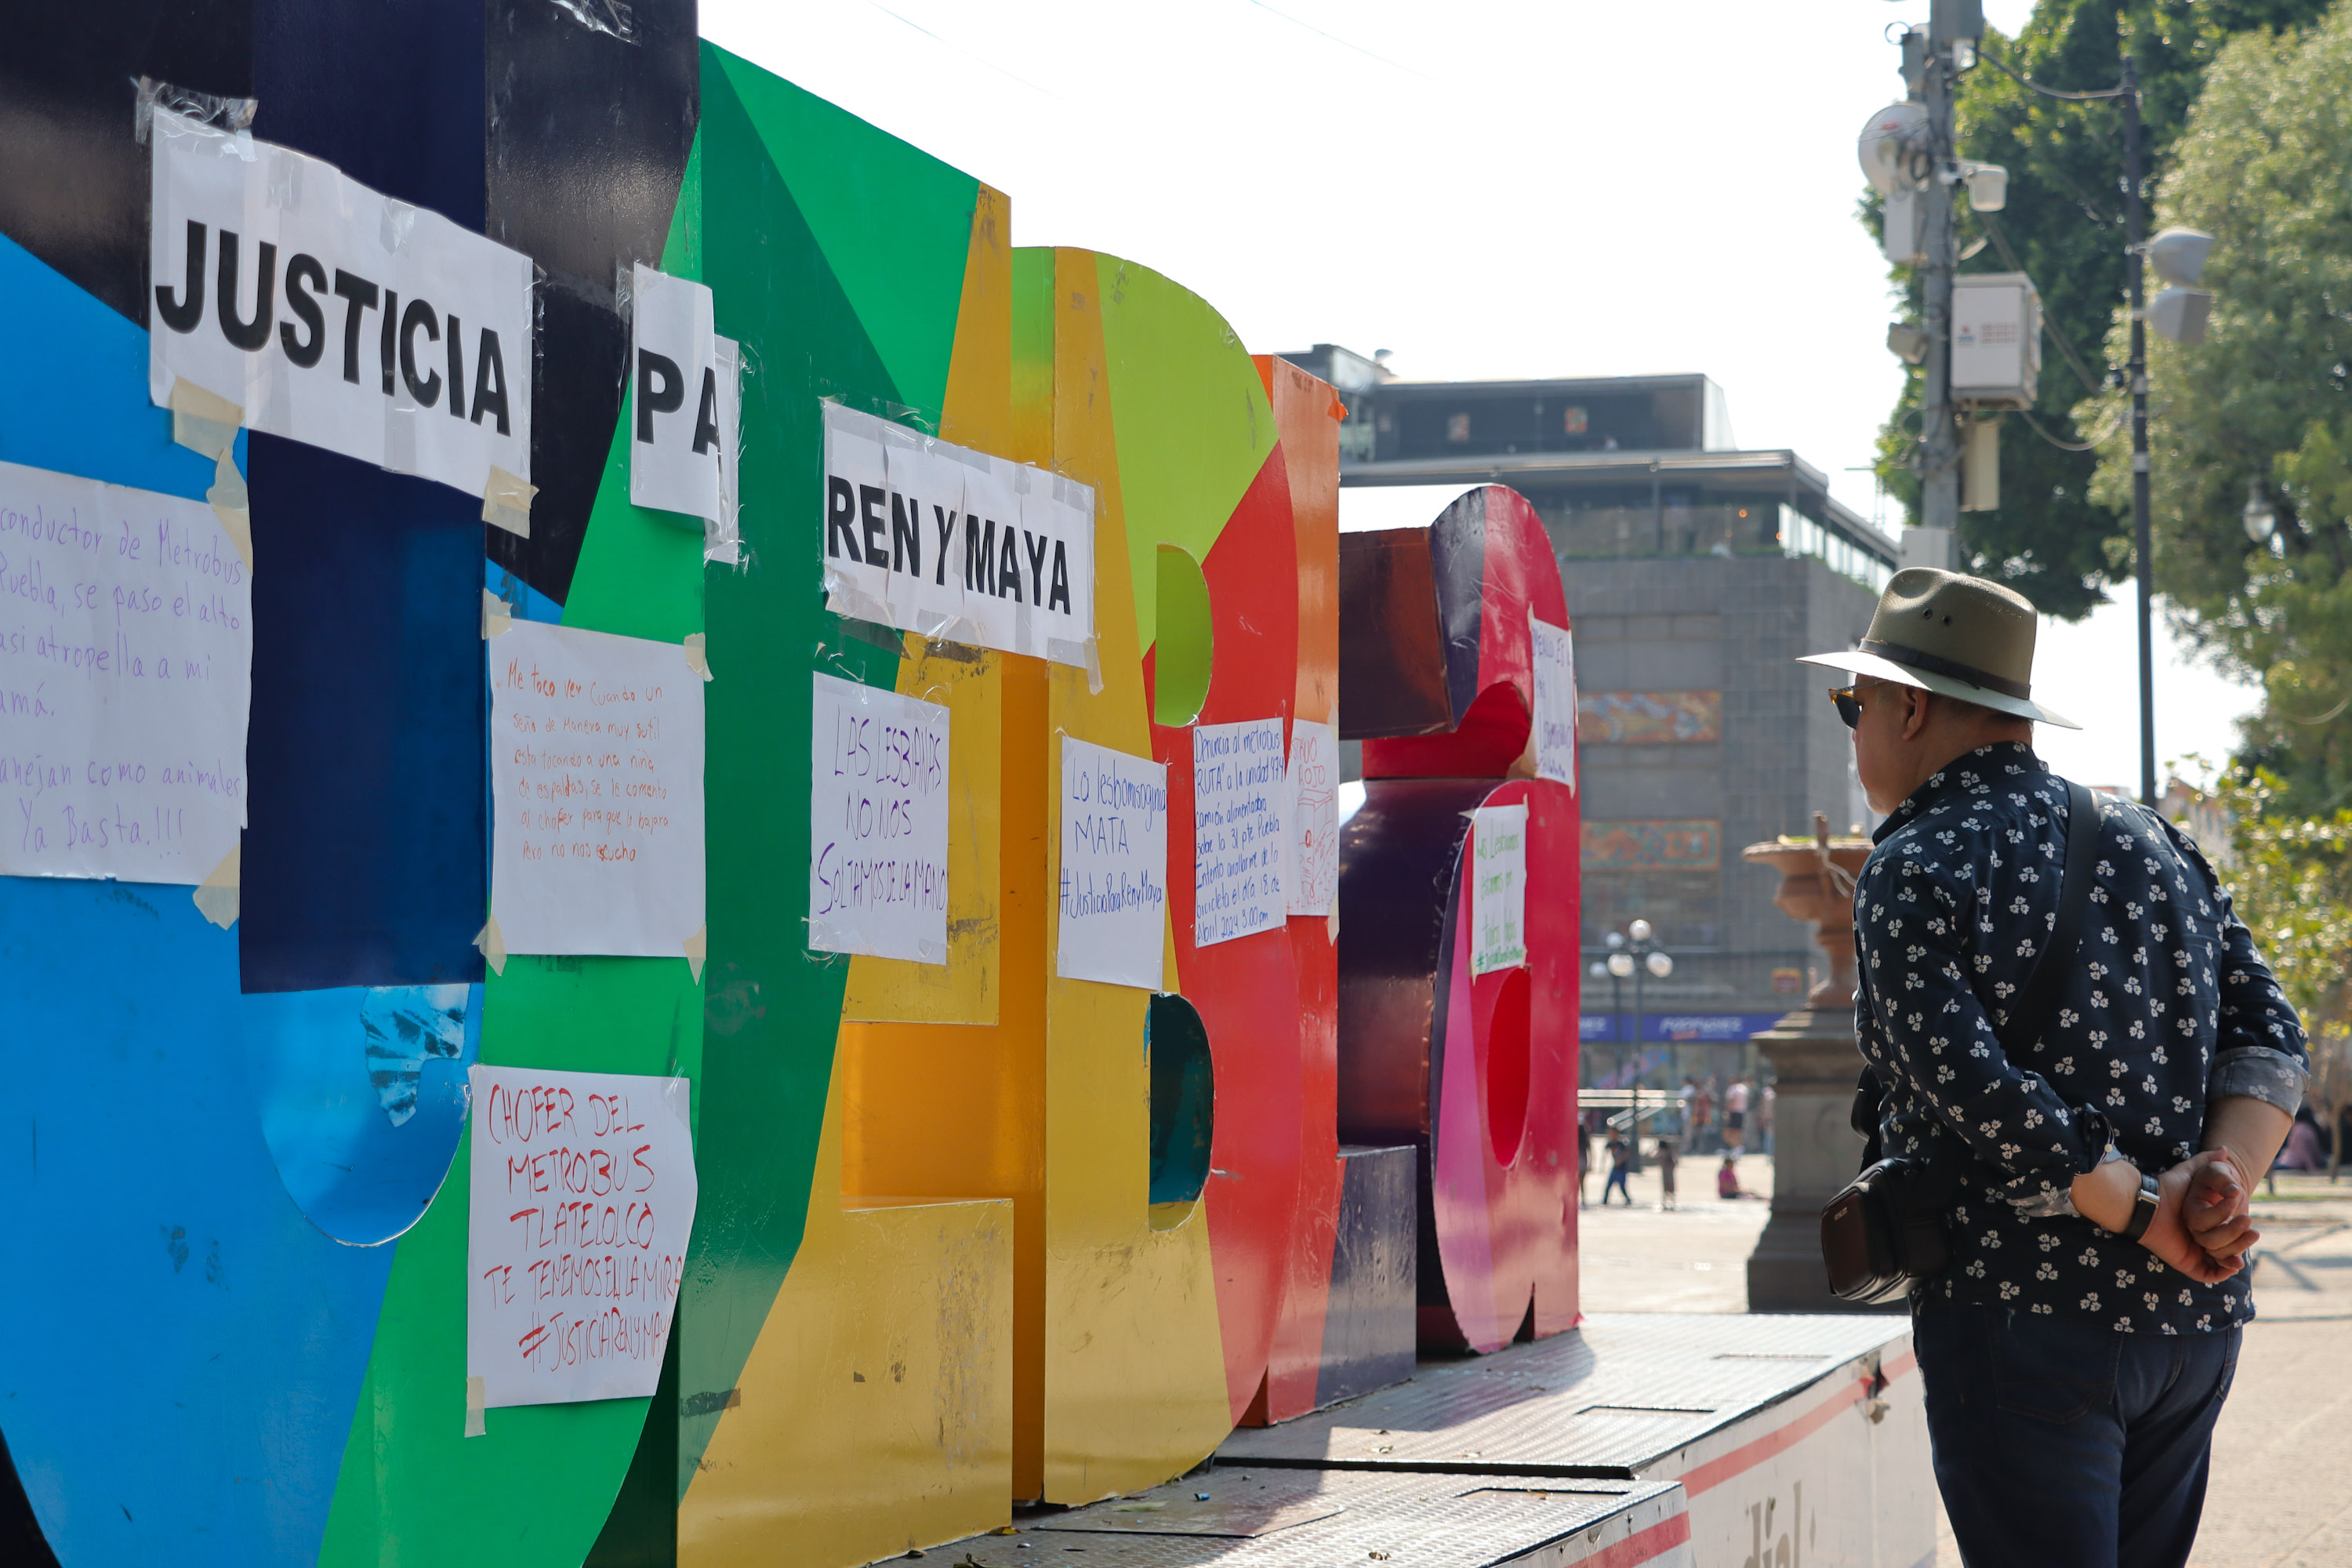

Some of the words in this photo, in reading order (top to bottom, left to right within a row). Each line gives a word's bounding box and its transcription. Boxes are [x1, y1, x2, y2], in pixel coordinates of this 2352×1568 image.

[155, 220, 511, 437] JUSTICIA
[119, 520, 140, 560] de
[158, 517, 242, 585] Metrobus
[828, 474, 920, 578] REN
[933, 504, 957, 586] Y
[966, 514, 1071, 615] MAYA
[74, 583, 97, 609] se
[114, 586, 162, 627] paso
[173, 582, 191, 617] el
[199, 593, 240, 630] alto
[37, 625, 145, 681] atropella
[158, 658, 170, 679] a
[185, 654, 211, 682] mi
[508, 656, 524, 690] Me
[531, 664, 556, 697] toco
[645, 685, 663, 702] un
[545, 716, 556, 733] de
[608, 724, 630, 741] muy
[834, 705, 872, 777] LAS
[1195, 729, 1230, 764] Denuncia
[1232, 725, 1241, 754] al
[1243, 722, 1281, 754] metrobus
[87, 760, 147, 786] como
[162, 758, 241, 797] animales
[514, 742, 536, 768] esta
[541, 750, 583, 771] tocando
[586, 753, 593, 766] a
[599, 753, 622, 768] una
[1227, 775, 1232, 791] a
[1235, 761, 1243, 792] la
[1247, 755, 1269, 787] unidad
[518, 775, 531, 800] de
[590, 779, 603, 797] se
[626, 777, 668, 800] comento
[19, 797, 48, 853] Ya
[521, 808, 532, 831] al
[582, 808, 603, 831] para
[605, 811, 622, 836] que
[637, 811, 670, 836] bajara
[846, 789, 873, 841] NO
[879, 797, 913, 840] NOS
[1075, 814, 1130, 856] MATA
[1257, 811, 1279, 839] Puebla
[550, 844, 566, 858] no
[572, 842, 592, 858] nos
[1261, 846, 1269, 868] de
[913, 856, 946, 913] MANO
[1232, 880, 1241, 906] el
[1270, 870, 1281, 893] de
[1221, 913, 1241, 939] 2024
[489, 1084, 577, 1144] CHOFER
[589, 1094, 645, 1137] DEL
[508, 1144, 655, 1200] METROBUS
[510, 1201, 655, 1252] TLATELOLCO
[484, 1265, 516, 1310] TE
[528, 1253, 603, 1305] TENEMOS
[626, 1254, 639, 1298] LA
